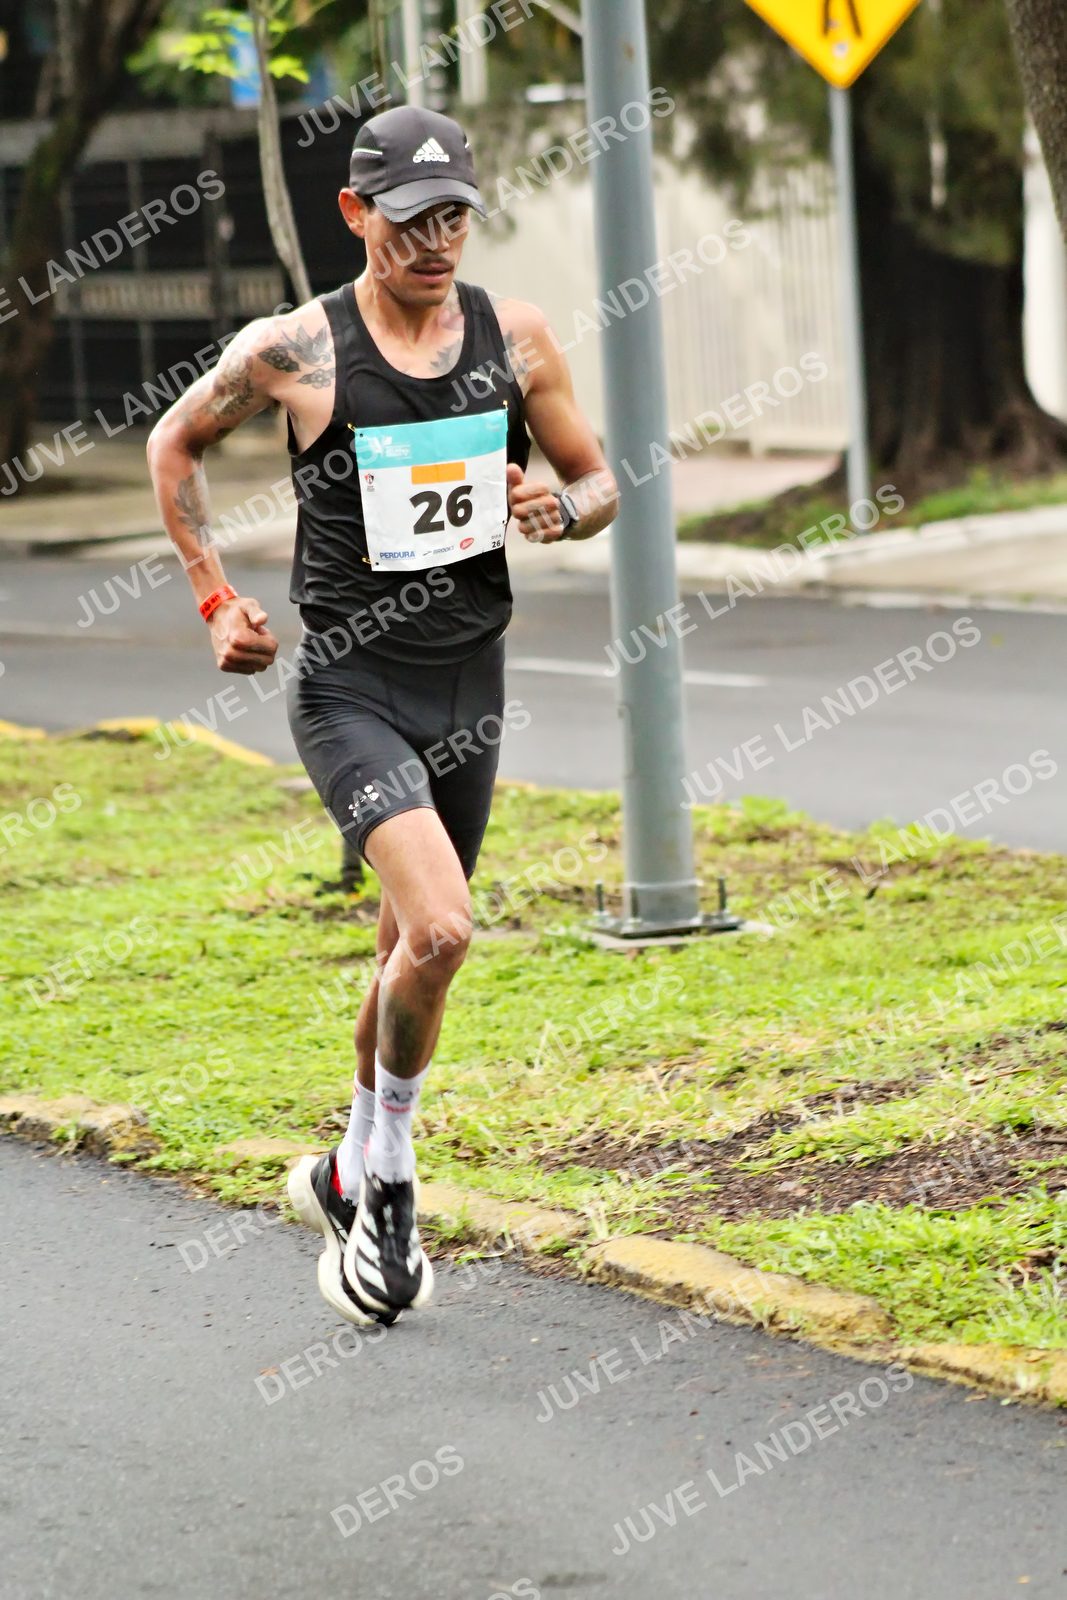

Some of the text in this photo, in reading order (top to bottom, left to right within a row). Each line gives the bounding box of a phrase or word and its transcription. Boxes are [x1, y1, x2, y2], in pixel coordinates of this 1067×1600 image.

[408, 485, 473, 535] 26
[492, 540, 501, 548] 26
[379, 551, 415, 559] PERDURA
